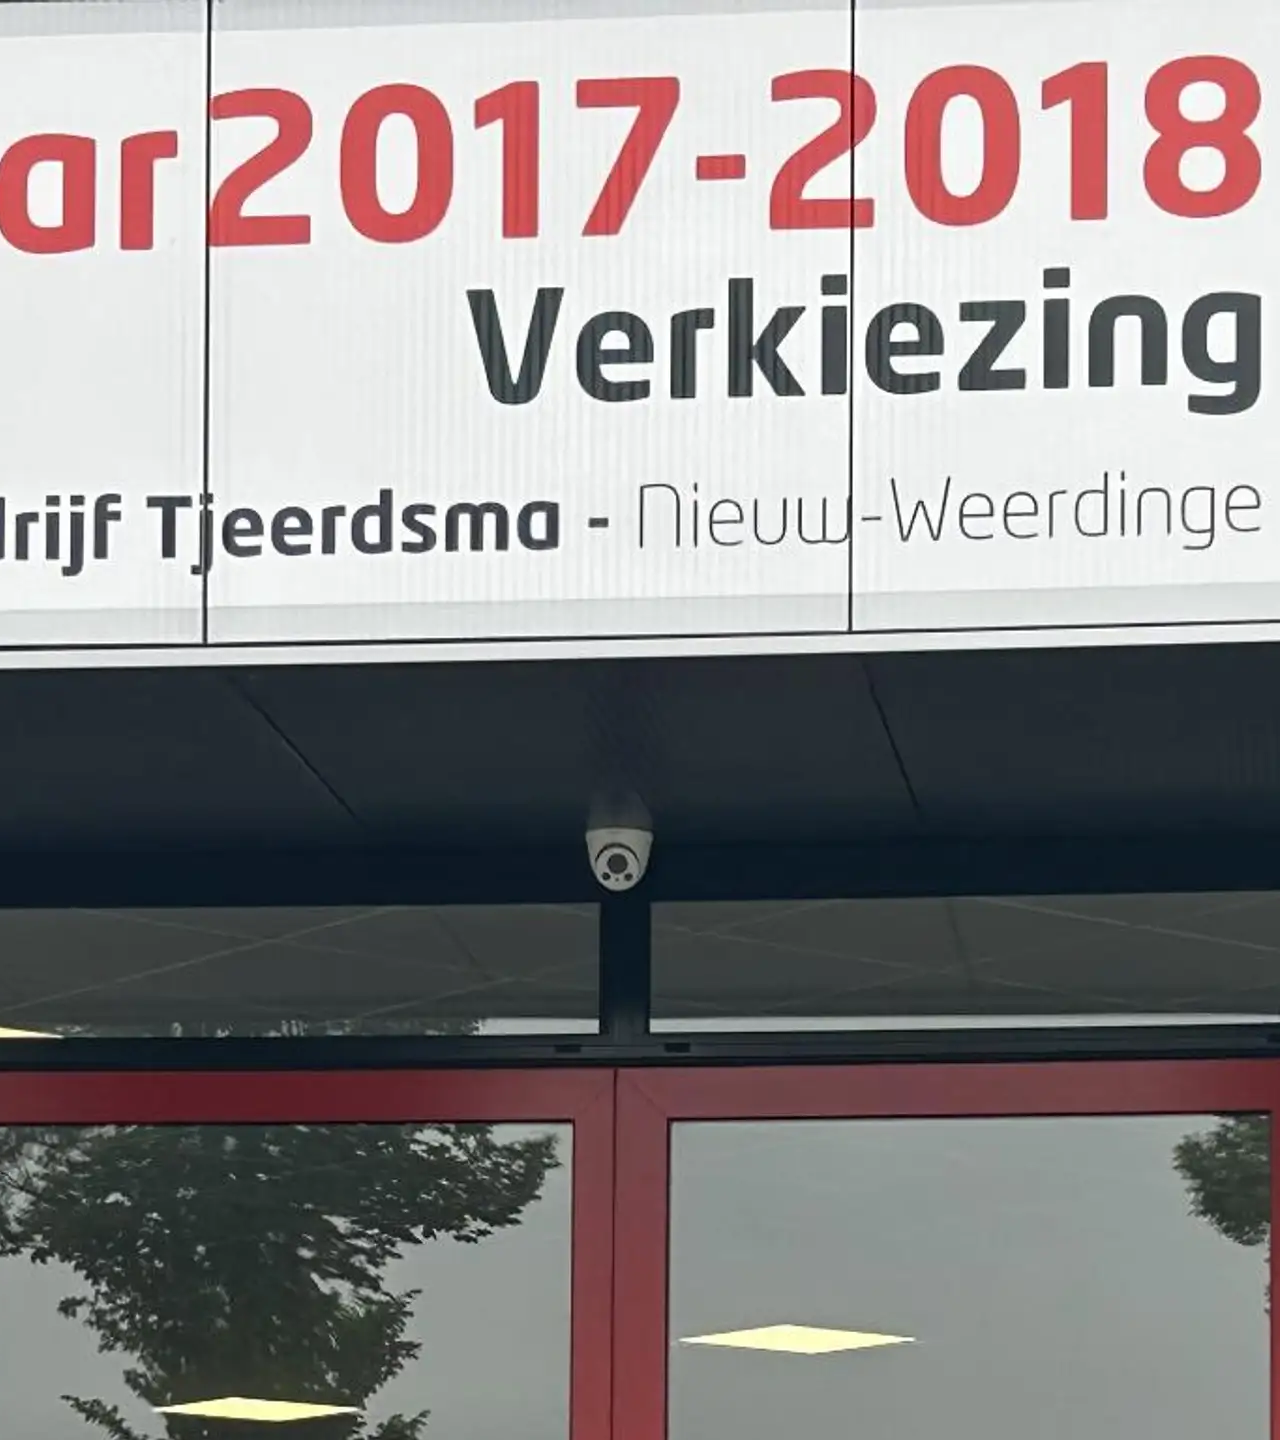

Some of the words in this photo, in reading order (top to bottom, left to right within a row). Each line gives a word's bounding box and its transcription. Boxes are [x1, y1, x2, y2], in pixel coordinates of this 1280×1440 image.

[207, 55, 1262, 247] 2017-2018
[466, 267, 1262, 416] Verkiezing
[146, 487, 559, 575] Tjeerdsma
[638, 470, 1262, 551] Nieuw-Weerdinge
